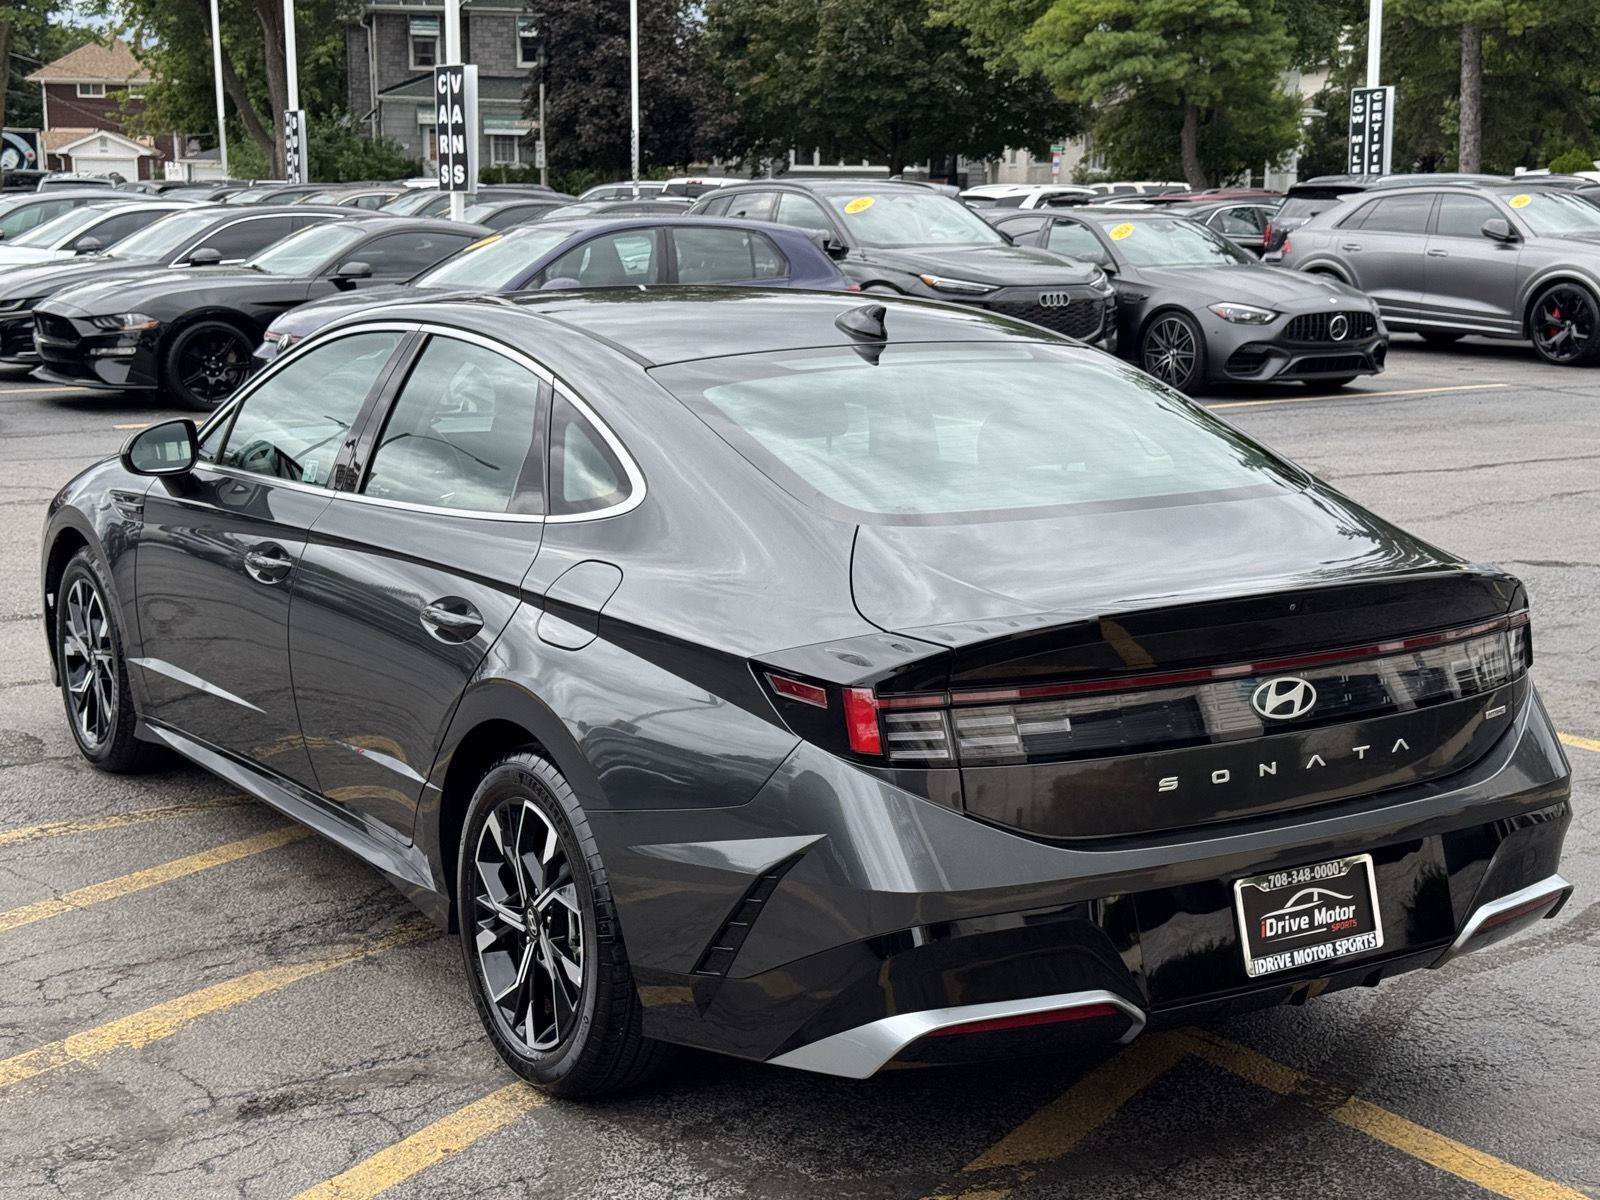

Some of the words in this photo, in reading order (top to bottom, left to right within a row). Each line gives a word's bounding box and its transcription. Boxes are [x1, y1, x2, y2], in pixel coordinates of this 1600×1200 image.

[1352, 95, 1364, 123] LOW
[438, 74, 450, 184] CARS
[450, 74, 465, 184] VANS
[1158, 738, 1410, 792] SONATA
[1268, 862, 1339, 888] 708-348-0000
[1260, 915, 1310, 938] iDrive
[1314, 905, 1356, 927] Motor
[1331, 919, 1357, 931] SPORTS
[1294, 942, 1335, 966] MOTOR
[1335, 933, 1376, 955] SPORTS
